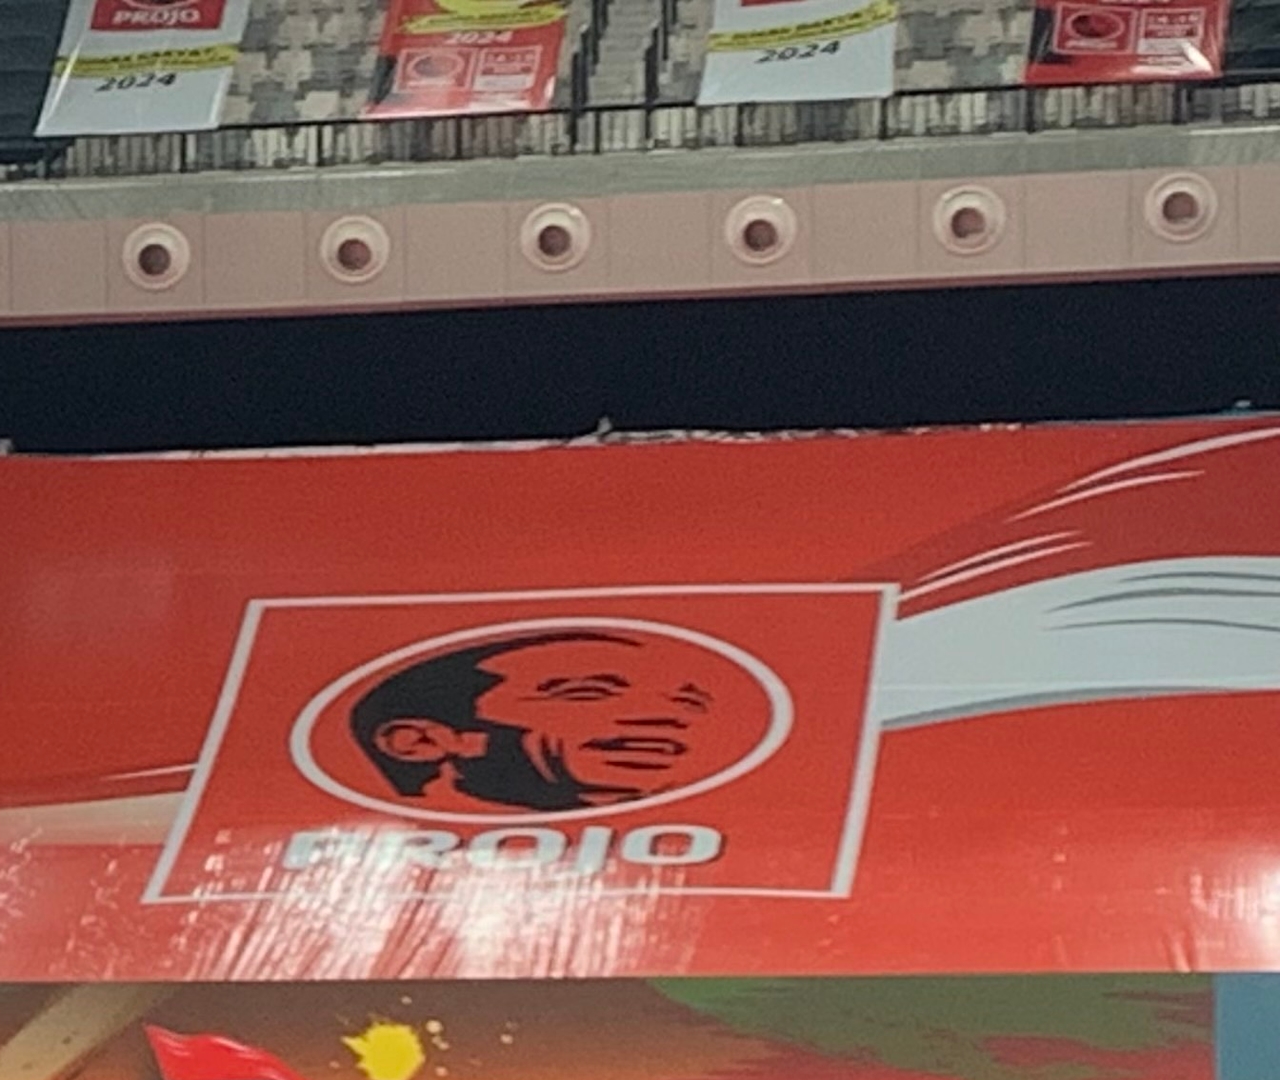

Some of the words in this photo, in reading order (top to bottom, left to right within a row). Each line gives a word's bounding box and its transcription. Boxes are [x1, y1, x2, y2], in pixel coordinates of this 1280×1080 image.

[111, 9, 202, 26] PROJO
[754, 40, 840, 64] 2024
[95, 73, 177, 92] 2024
[282, 823, 724, 876] PROJO
